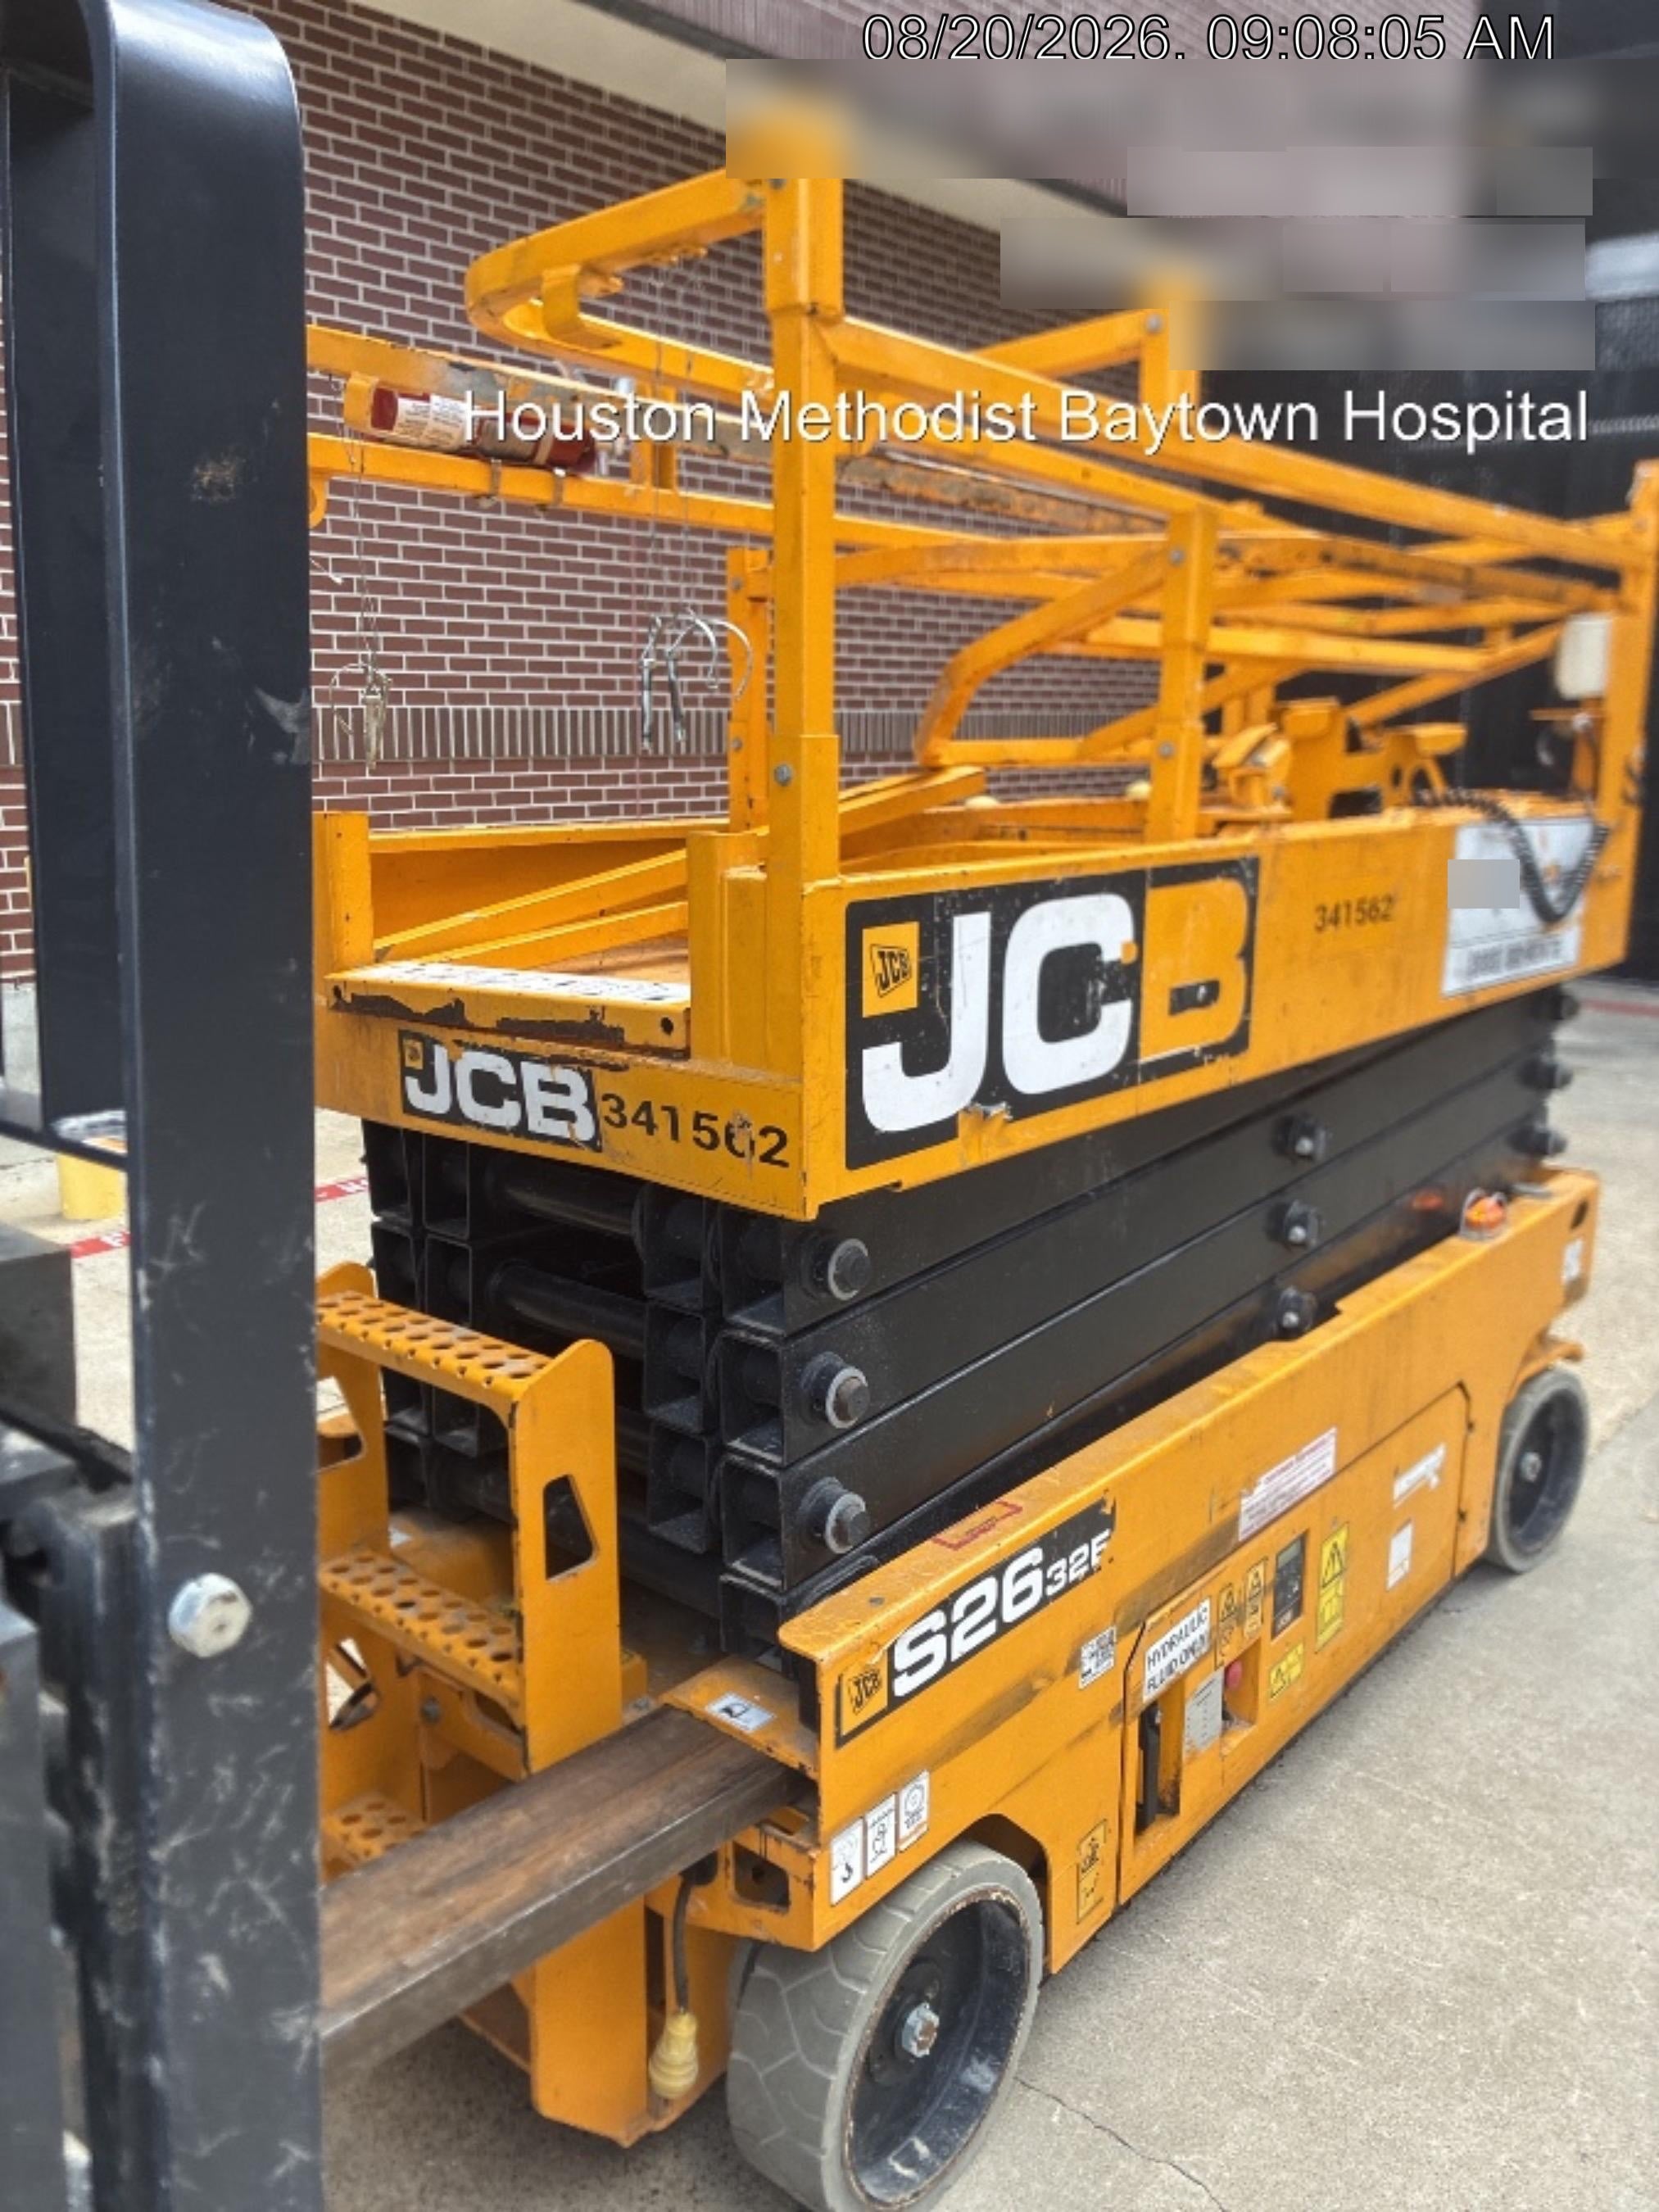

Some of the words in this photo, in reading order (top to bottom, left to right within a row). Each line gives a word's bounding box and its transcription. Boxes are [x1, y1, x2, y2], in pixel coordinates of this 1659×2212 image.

[1314, 893, 1394, 933] 341562
[862, 877, 1249, 1133] JCB
[877, 950, 909, 991] JCB
[405, 1044, 596, 1141] JCB
[601, 1092, 790, 1168] 341562
